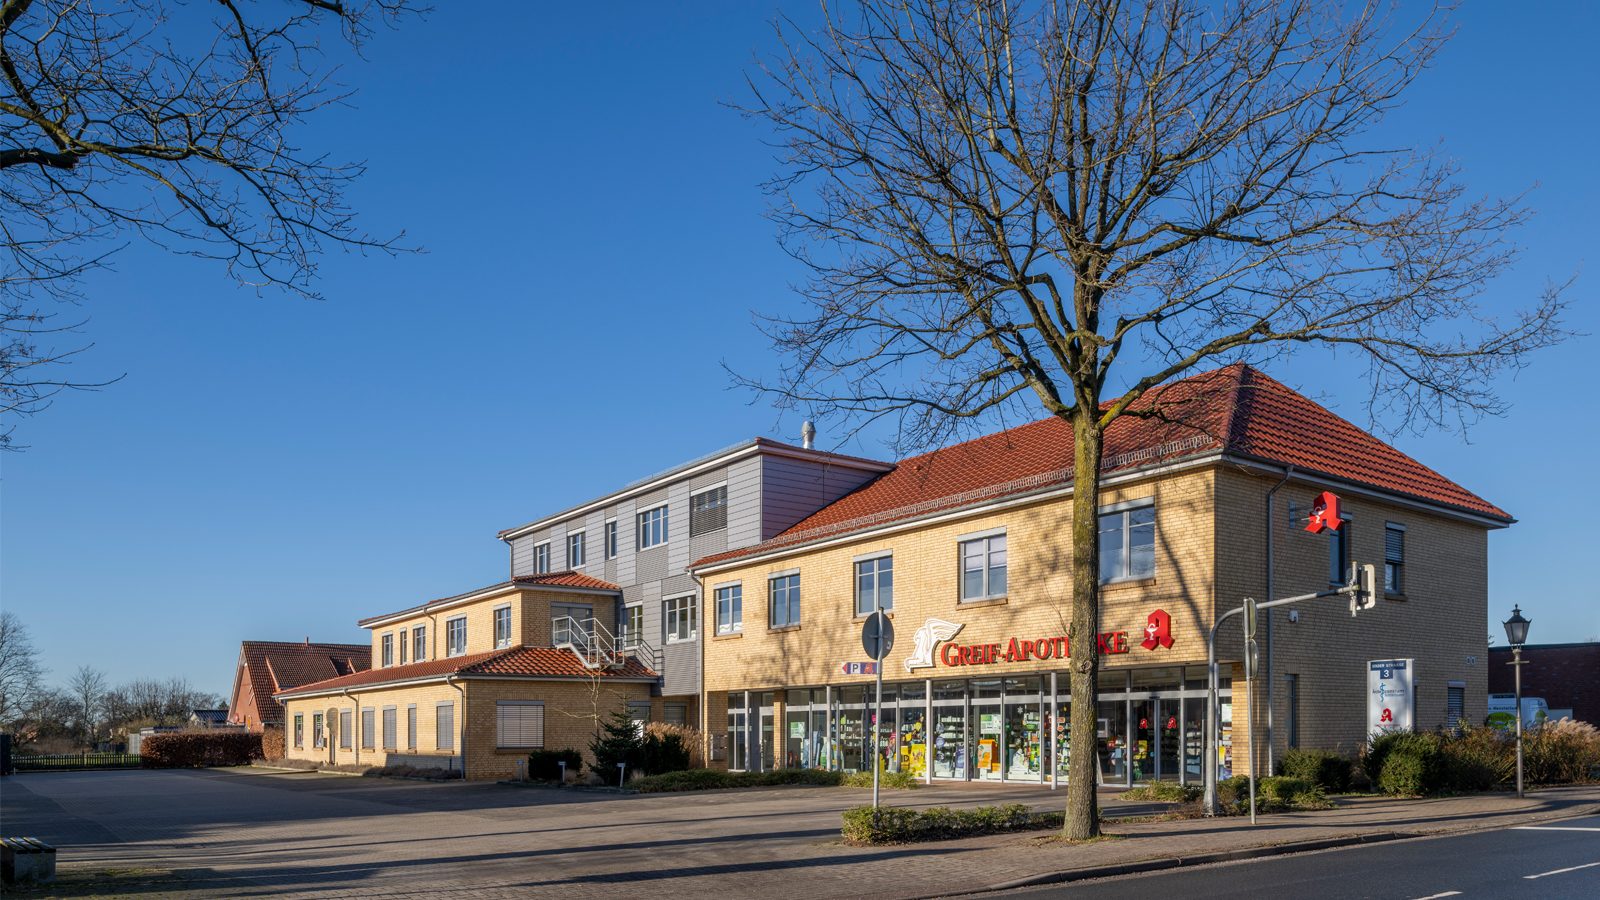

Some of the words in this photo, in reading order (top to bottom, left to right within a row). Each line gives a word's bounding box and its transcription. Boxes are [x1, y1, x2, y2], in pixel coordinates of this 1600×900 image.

[940, 631, 1129, 666] GREIF-APOTKE
[852, 663, 859, 673] P
[1383, 670, 1390, 678] 3
